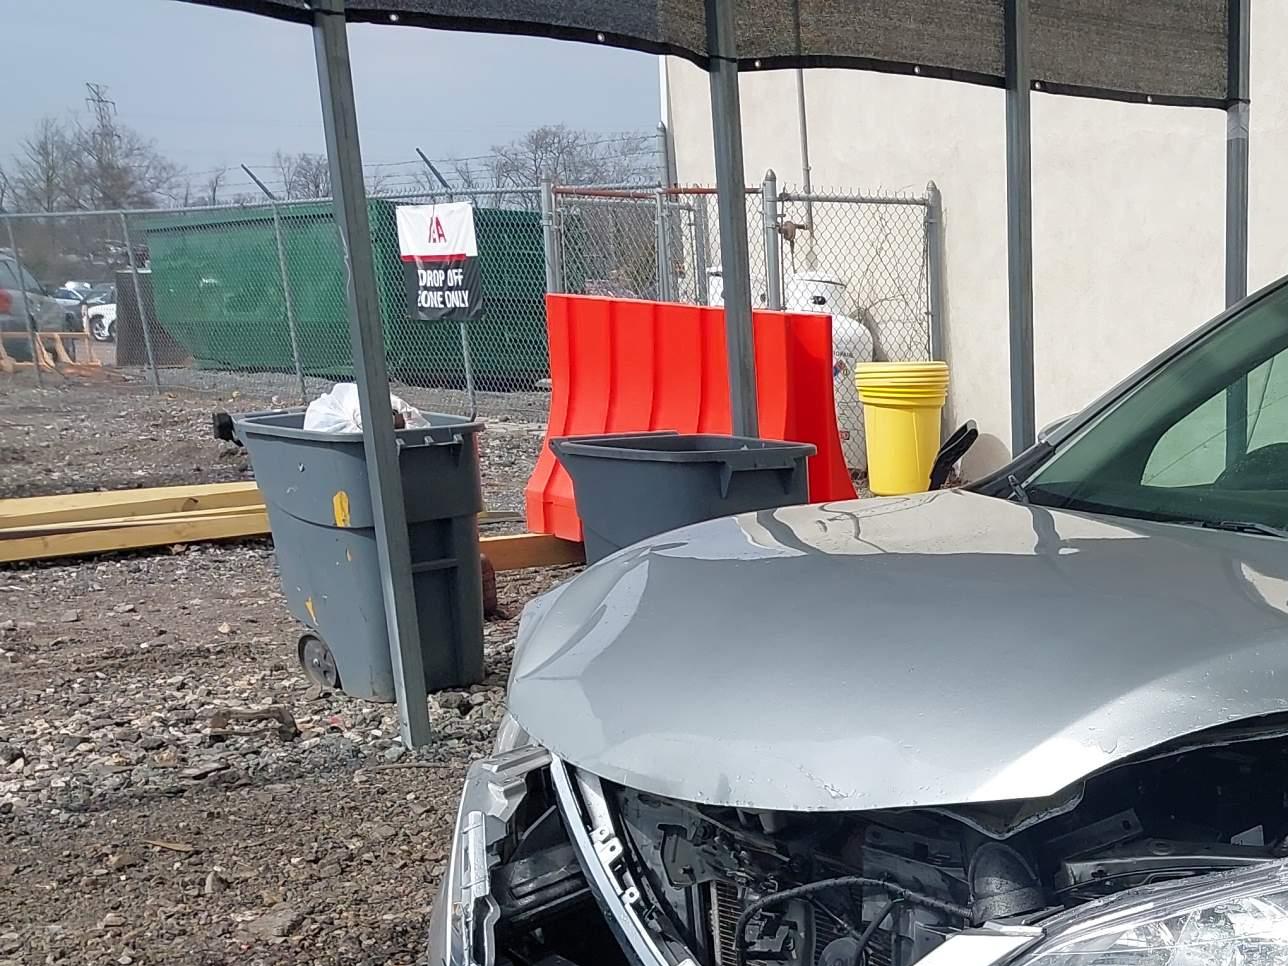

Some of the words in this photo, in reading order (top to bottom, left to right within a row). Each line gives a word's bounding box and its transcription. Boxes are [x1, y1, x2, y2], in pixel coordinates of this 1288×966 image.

[417, 269, 445, 287] DROP
[446, 268, 464, 287] OFF
[444, 290, 469, 308] ONLY
